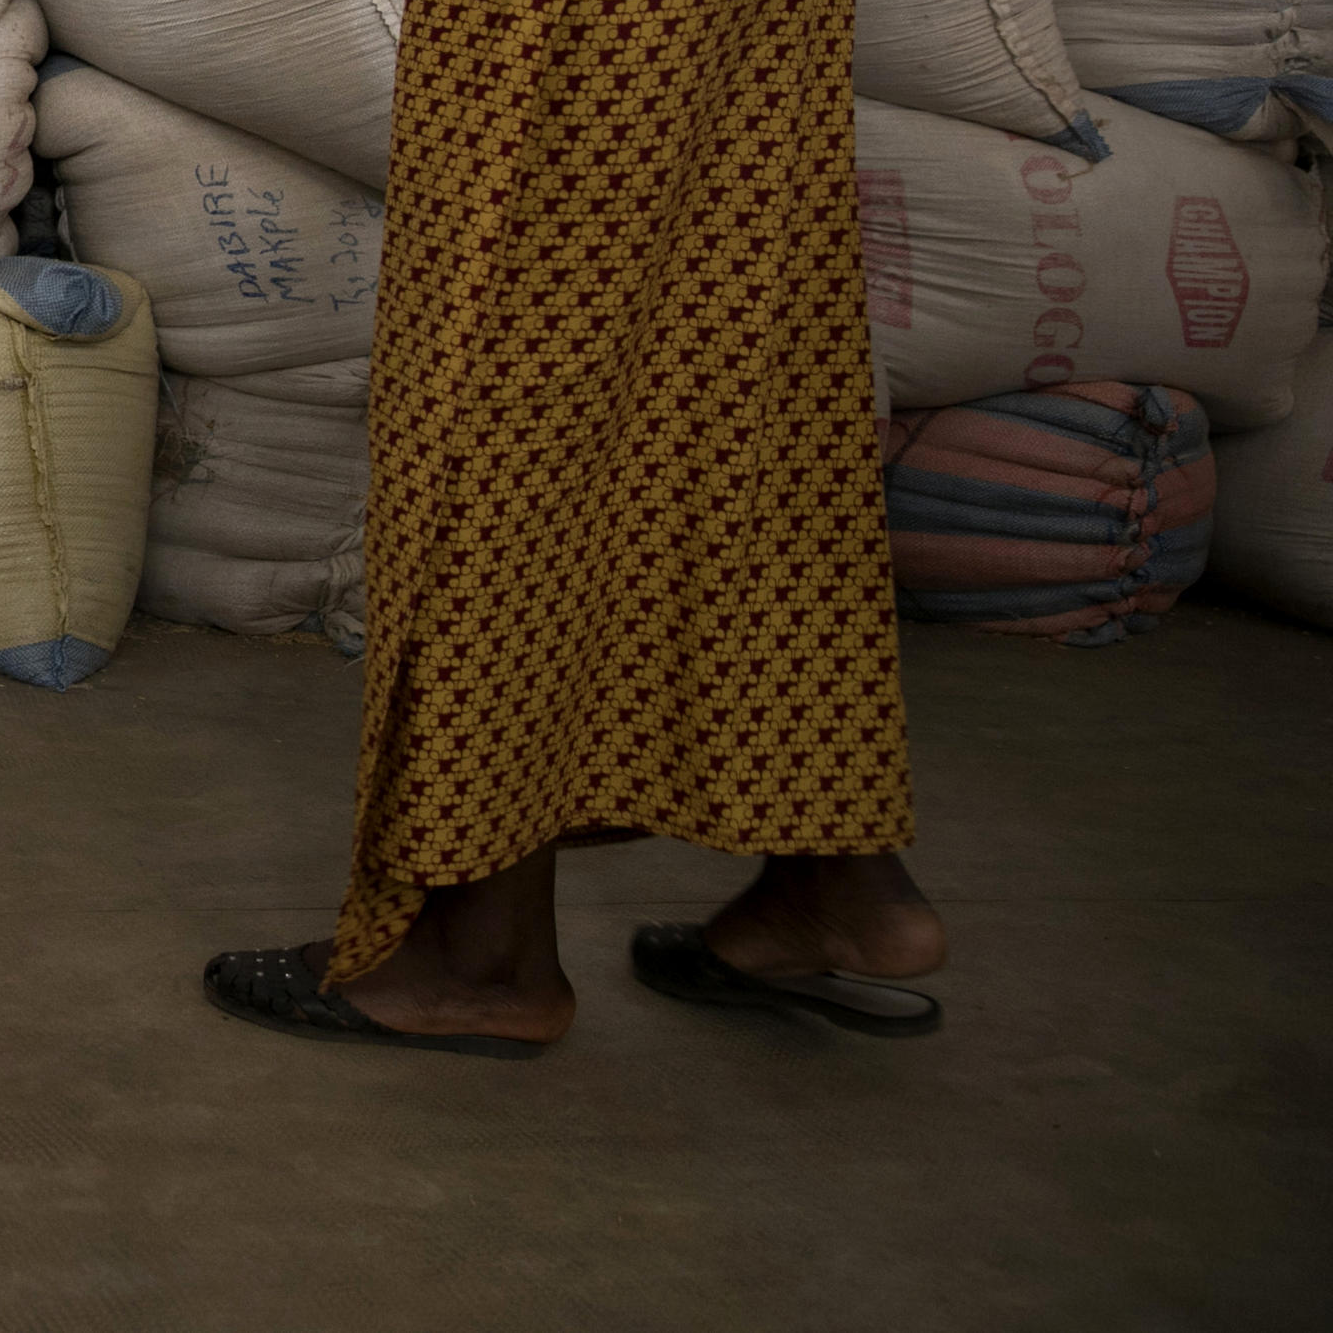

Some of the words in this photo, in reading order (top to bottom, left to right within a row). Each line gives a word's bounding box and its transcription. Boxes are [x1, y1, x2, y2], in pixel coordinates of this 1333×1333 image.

[196, 164, 268, 304] DABIRE
[1020, 154, 1087, 388] OLOGO
[1169, 200, 1246, 345] CHAMPION
